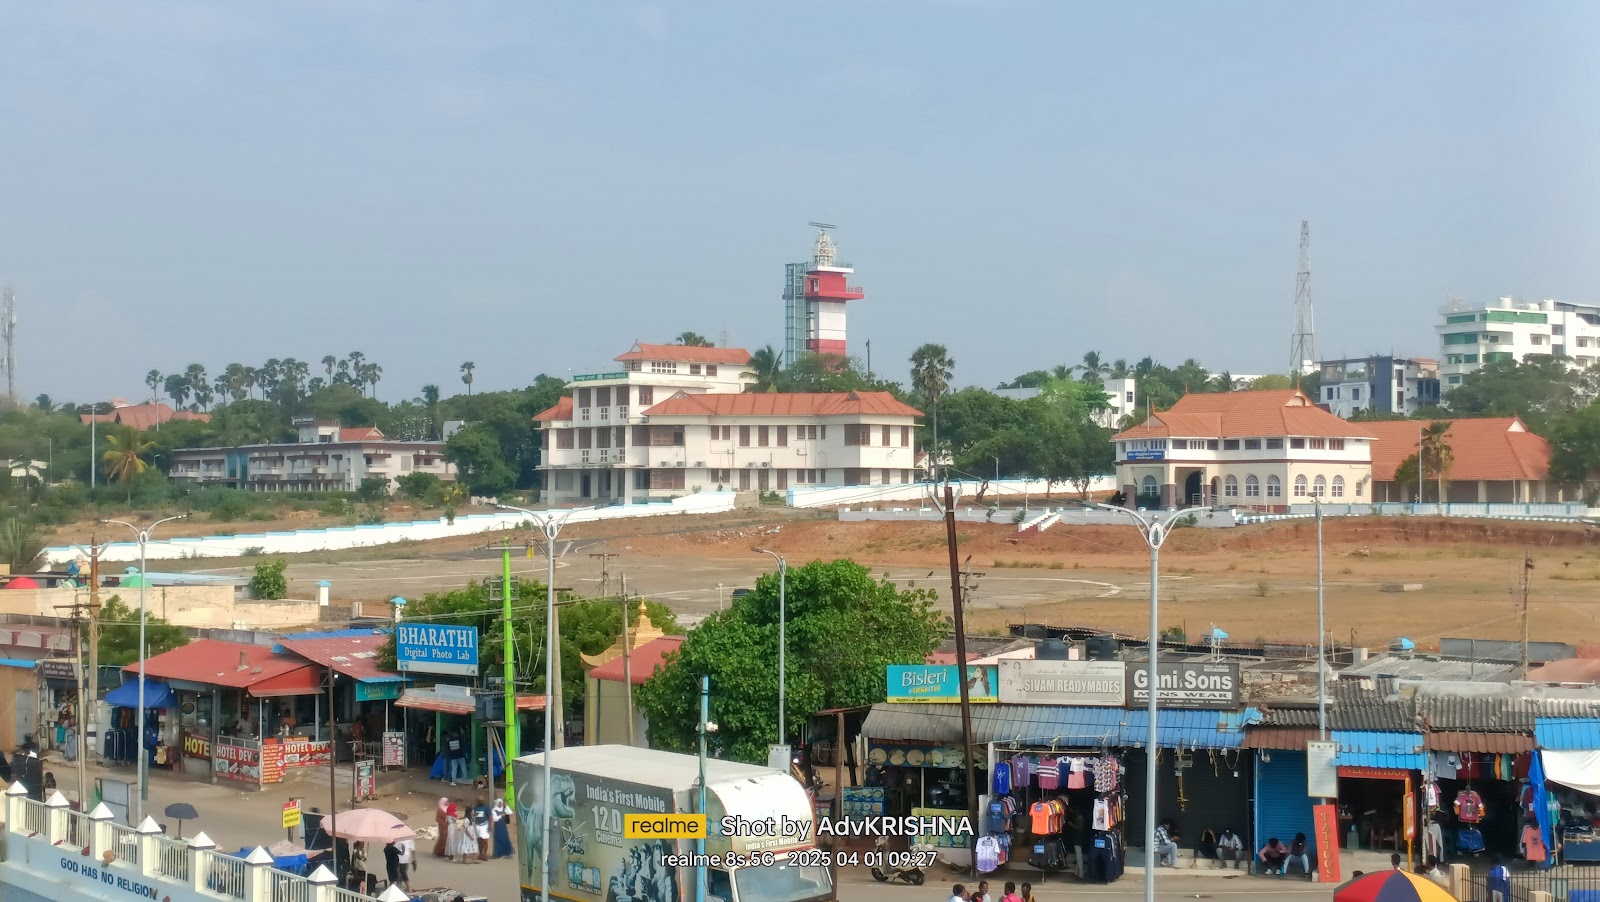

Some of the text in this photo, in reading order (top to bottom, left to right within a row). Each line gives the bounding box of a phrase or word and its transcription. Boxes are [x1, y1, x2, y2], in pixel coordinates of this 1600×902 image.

[399, 627, 474, 648] BHARATHI
[404, 647, 470, 660] Digital Photo Lab
[901, 668, 947, 688] Bisleri
[1024, 679, 1121, 694] SIVAM READYMADES
[1184, 670, 1233, 690] Sons
[184, 736, 210, 757] HOTE
[216, 745, 237, 760] HOTEL
[285, 744, 309, 754] HOTEL
[586, 784, 666, 813] India's First Mobile
[591, 805, 623, 835] 12 D
[595, 829, 623, 848] Cinema
[745, 840, 765, 851] India's
[765, 838, 778, 848] First
[778, 836, 798, 845] Mobile
[60, 857, 158, 899] GOD HAS NO RELIGION
